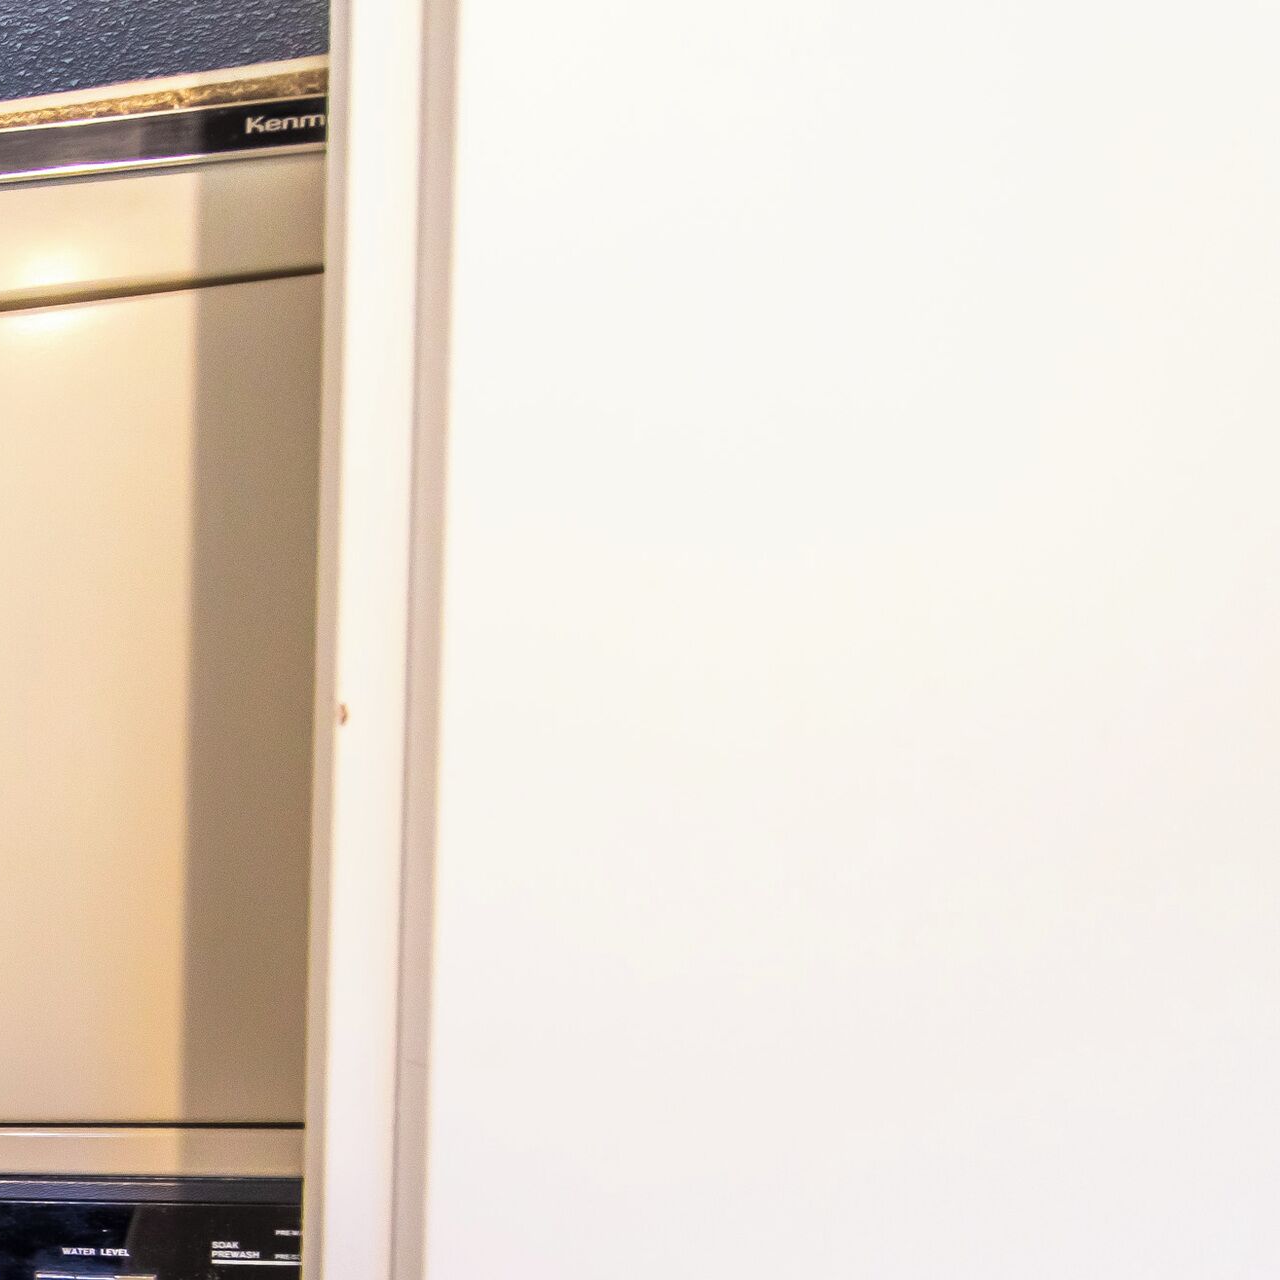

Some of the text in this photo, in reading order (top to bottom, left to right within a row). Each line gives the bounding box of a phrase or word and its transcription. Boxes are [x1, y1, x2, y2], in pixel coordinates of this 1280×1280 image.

[245, 114, 326, 134] Kenm
[212, 1241, 239, 1249] SOAK
[62, 1248, 130, 1256] WATER LEVEL
[211, 1250, 260, 1259] PREWASH
